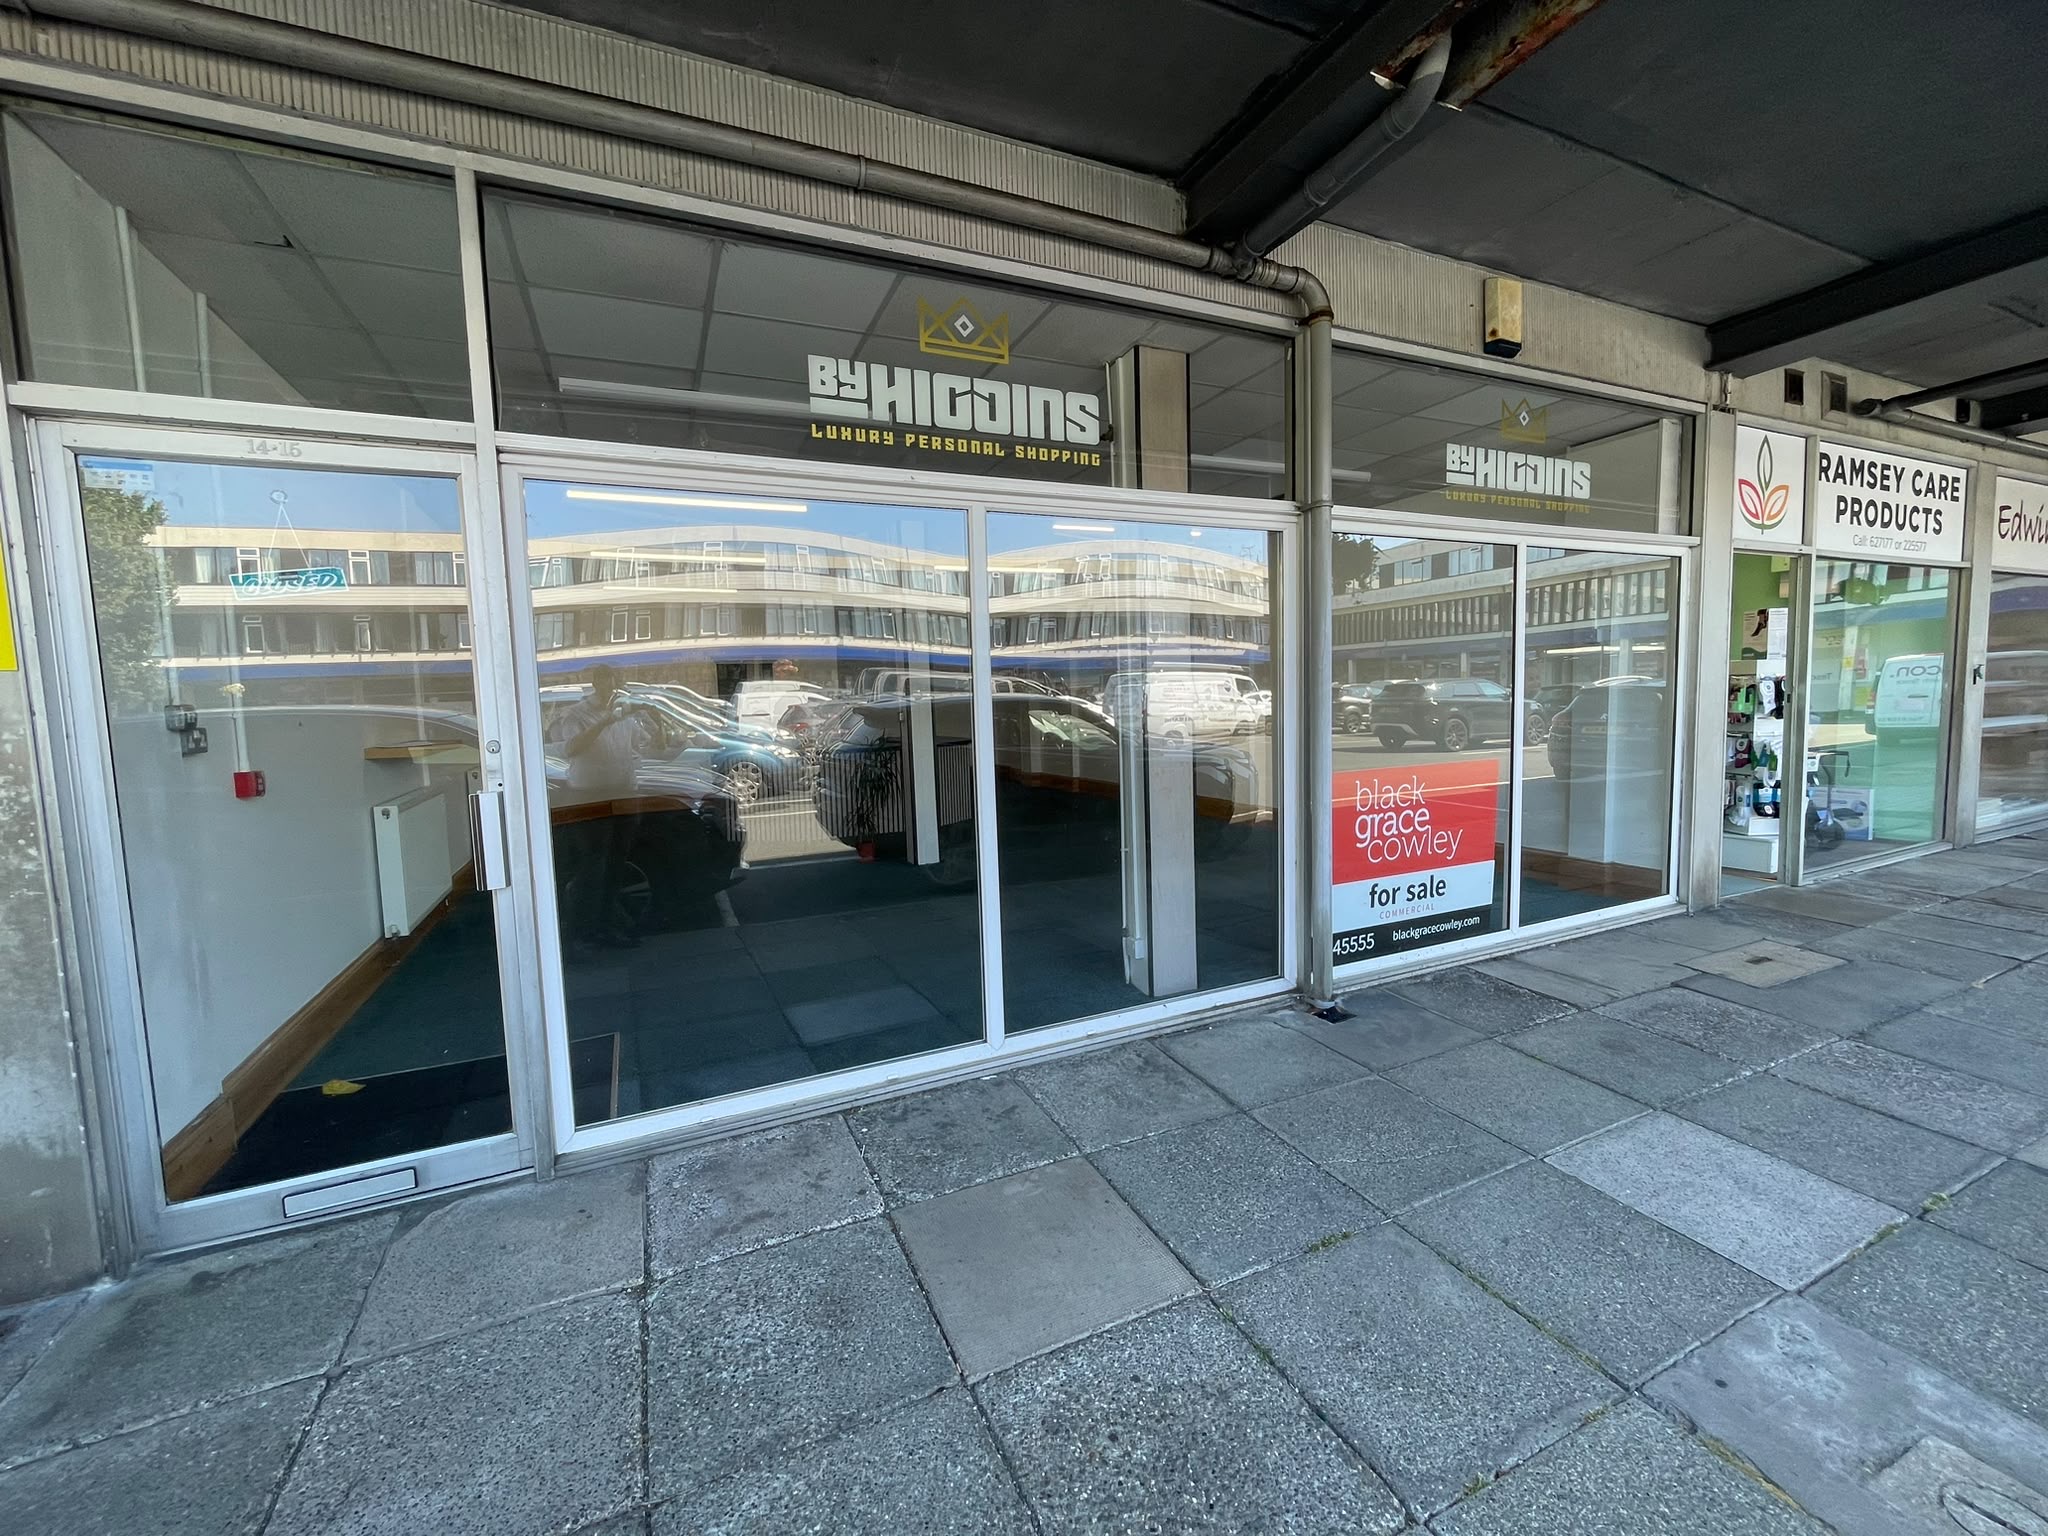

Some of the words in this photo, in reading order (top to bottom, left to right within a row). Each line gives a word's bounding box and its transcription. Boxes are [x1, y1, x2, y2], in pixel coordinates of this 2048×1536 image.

[811, 423, 894, 446] LUXURY
[905, 433, 1005, 457] PERSONAL
[1015, 445, 1100, 466] SHOPPING
[1818, 451, 1906, 494] RAMSEY
[1911, 469, 1960, 502] CARE
[1835, 495, 1943, 535] PRODUCTS
[243, 572, 338, 596] CLOSED
[1355, 775, 1426, 812] black
[1355, 807, 1430, 848] grace
[1367, 825, 1464, 864] cowley
[1369, 883, 1400, 909] for
[1406, 874, 1447, 902] sale
[1379, 902, 1435, 920] COMMERCIAL
[1392, 915, 1480, 942] blackgracecowley.com
